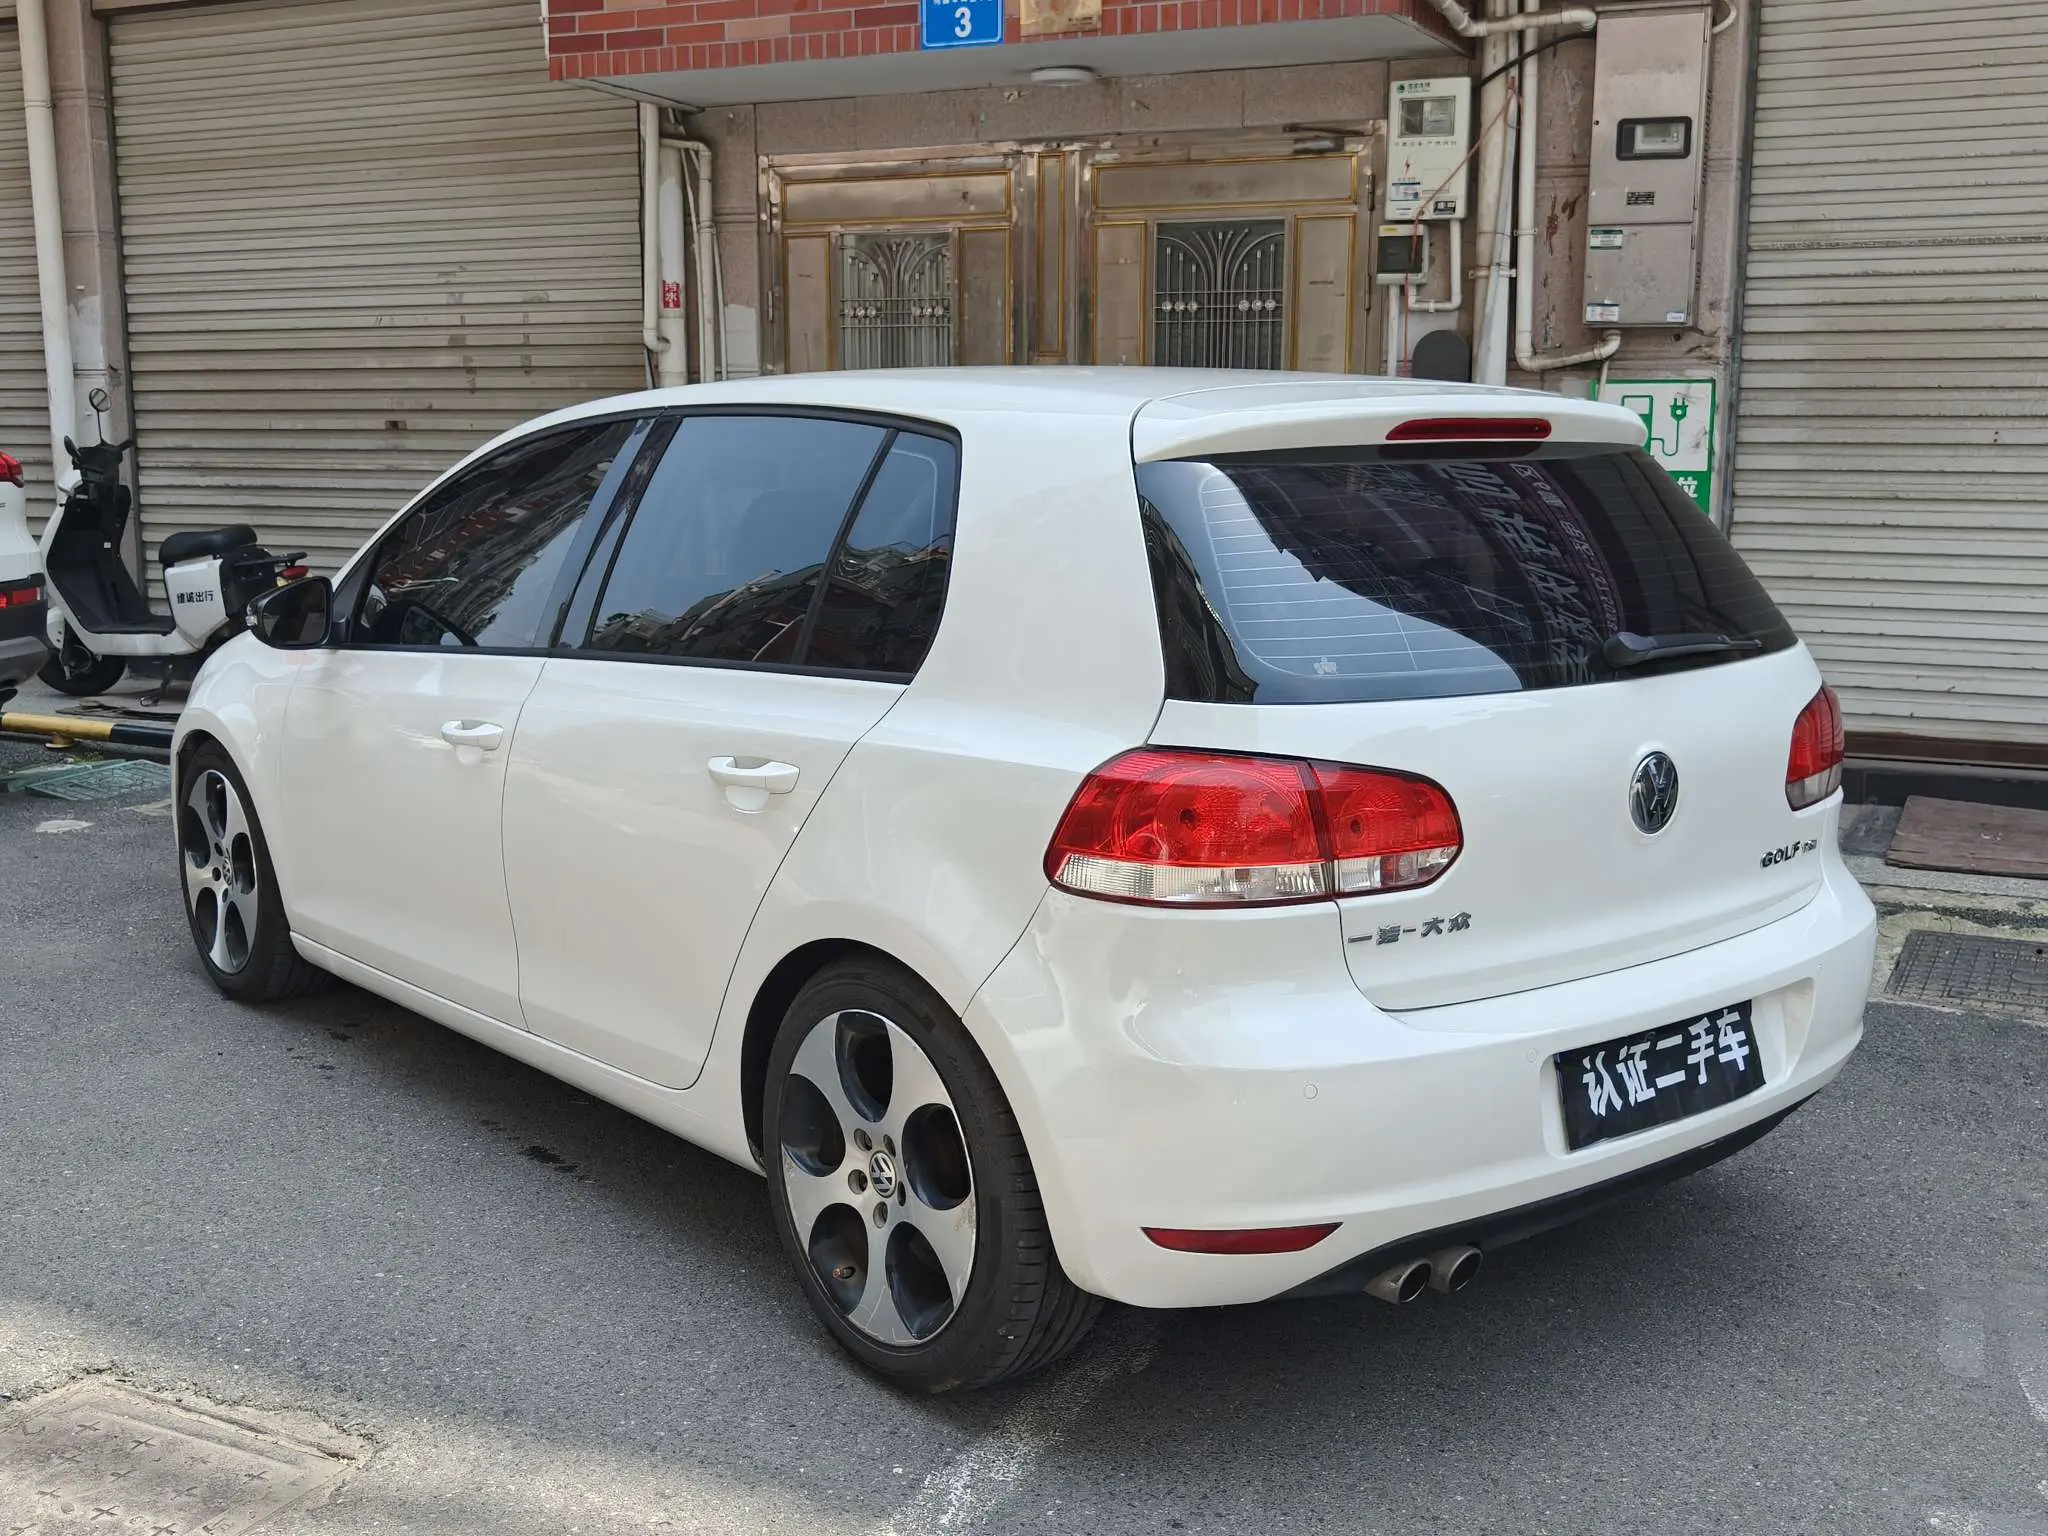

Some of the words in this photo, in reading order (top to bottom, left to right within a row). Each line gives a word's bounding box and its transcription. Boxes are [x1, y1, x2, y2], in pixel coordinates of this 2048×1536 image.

[954, 6, 972, 38] 3
[1760, 840, 1801, 868] GOLF
[1582, 1008, 1750, 1118] 认证二手车
